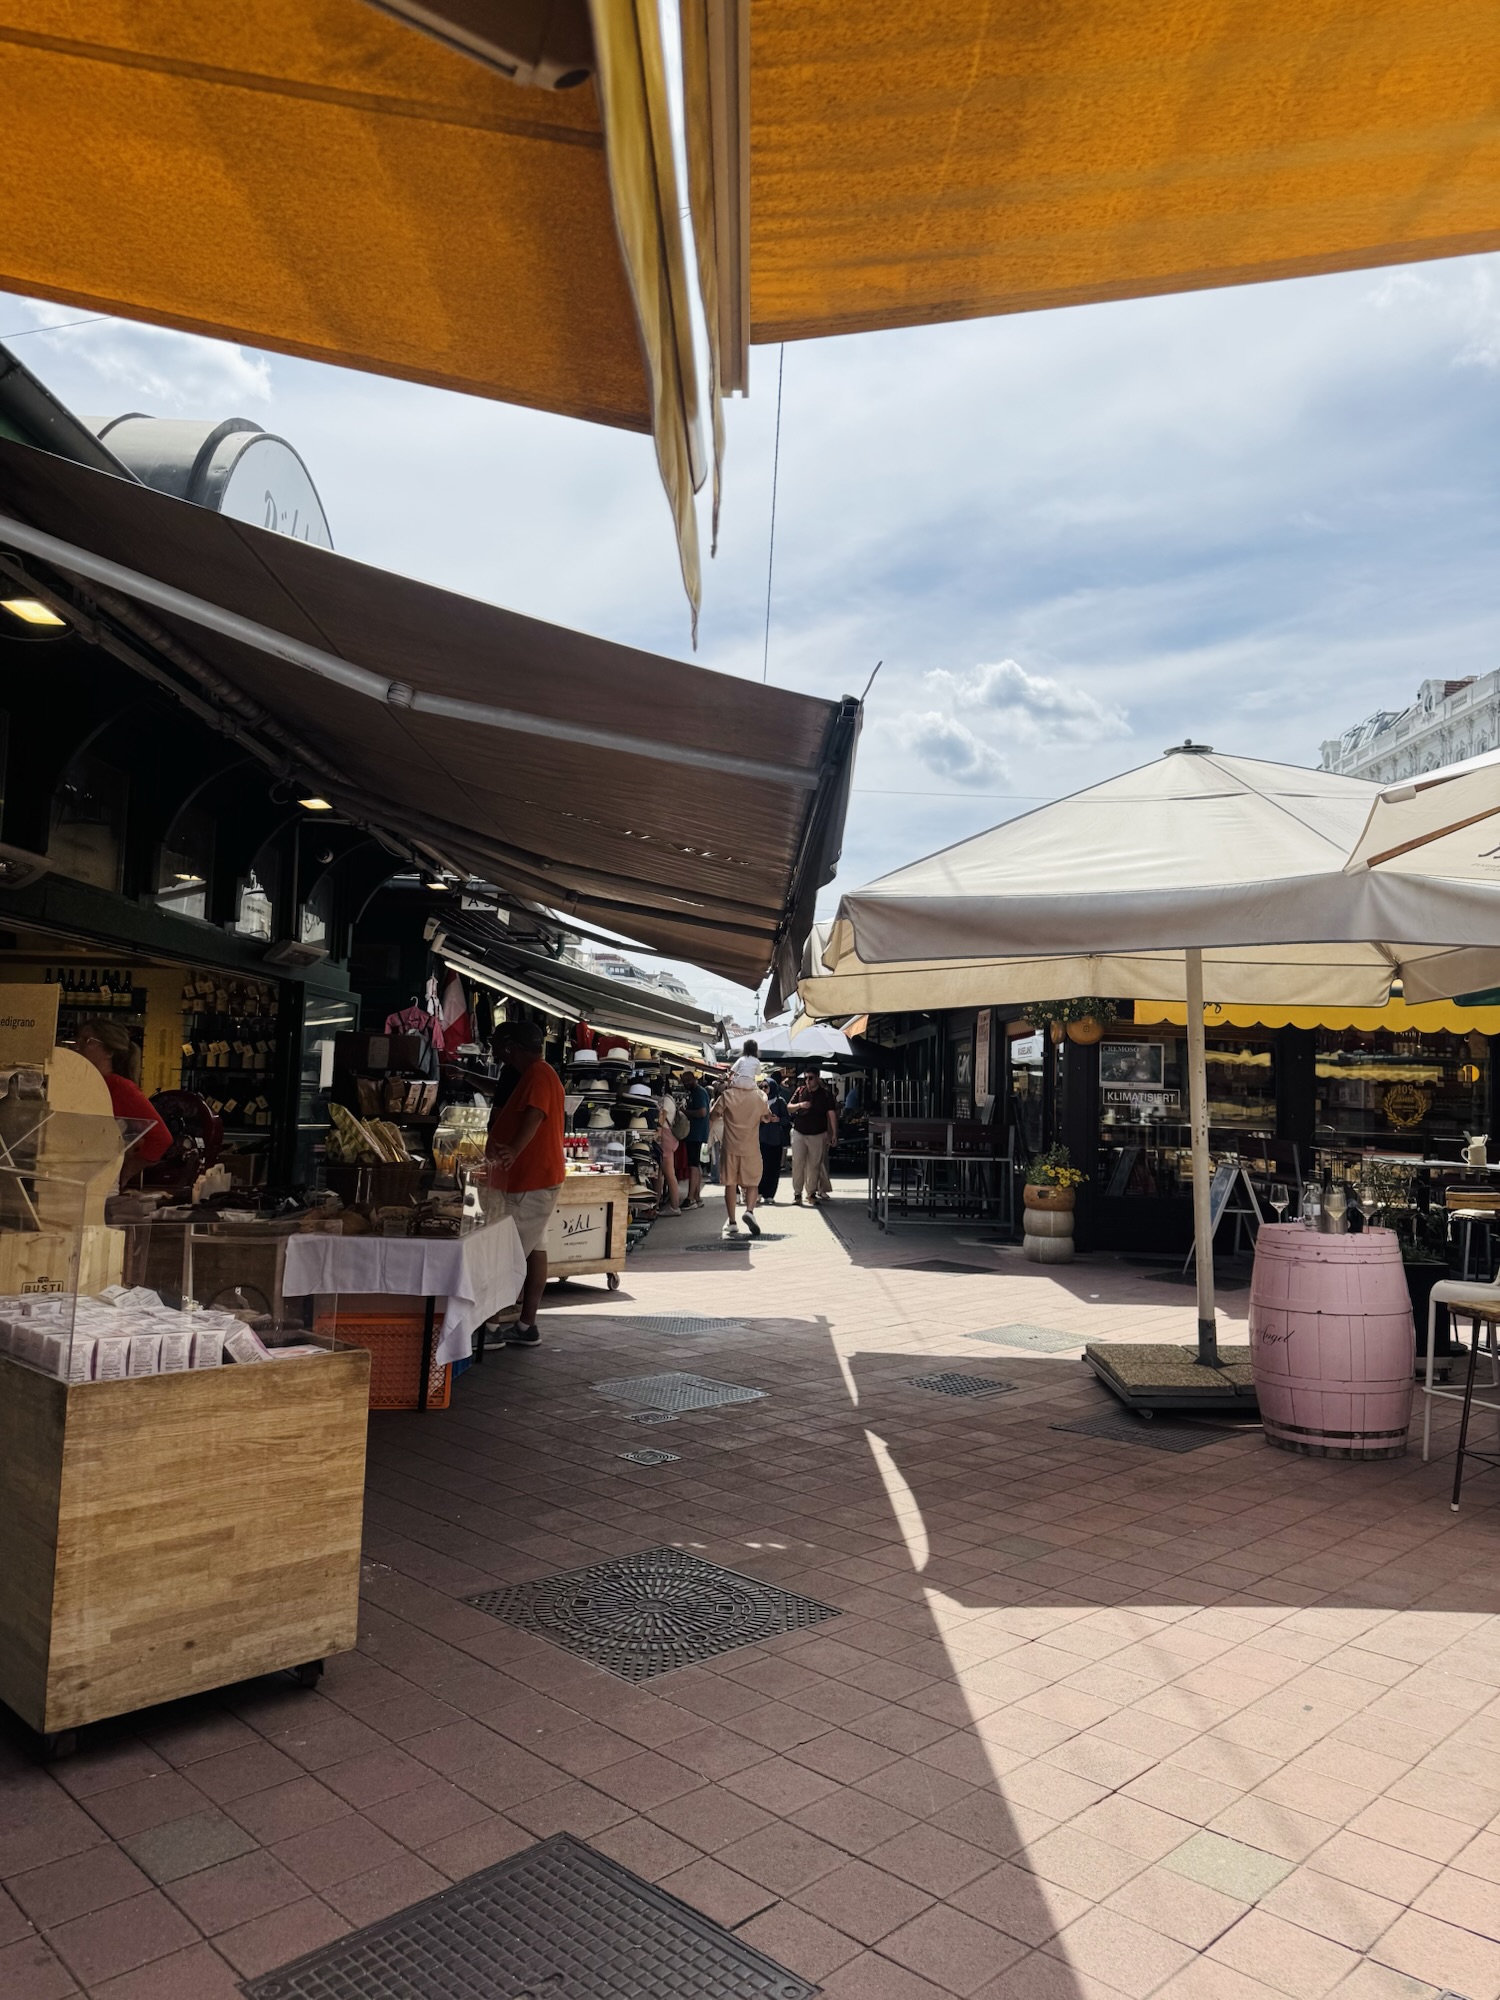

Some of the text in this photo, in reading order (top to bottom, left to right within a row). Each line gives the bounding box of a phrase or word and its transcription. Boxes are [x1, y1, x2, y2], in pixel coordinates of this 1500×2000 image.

[1102, 1045, 1140, 1053] CREMOSO
[1107, 1091, 1176, 1103] KLIMATISIERT
[24, 1283, 61, 1293] BUSTI
